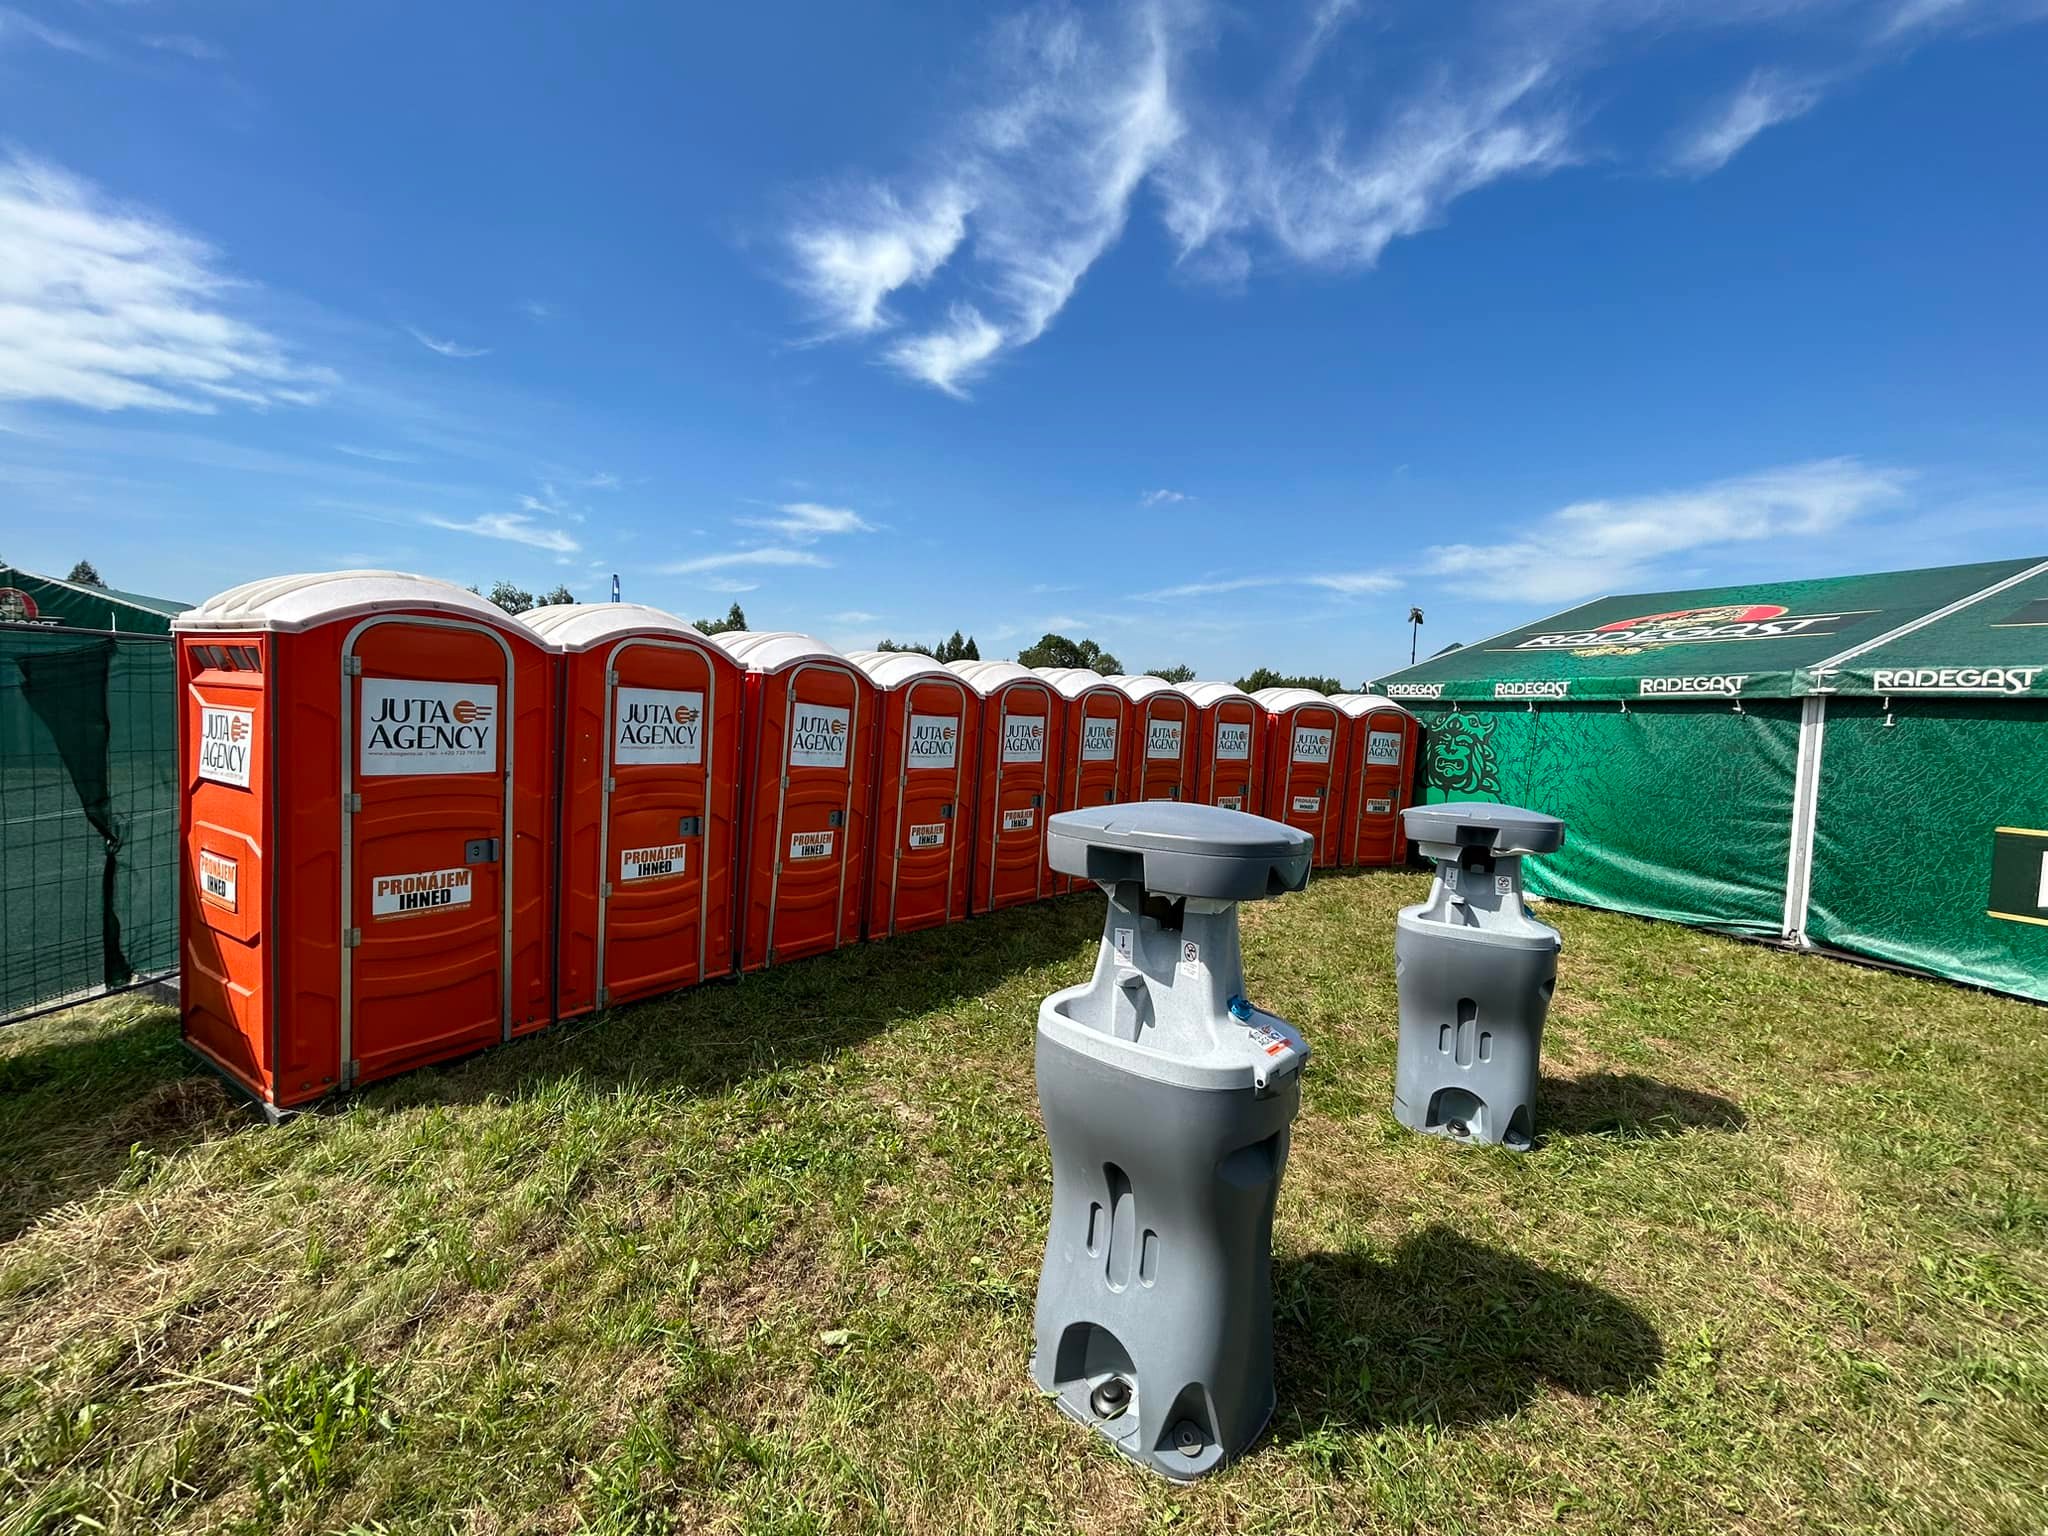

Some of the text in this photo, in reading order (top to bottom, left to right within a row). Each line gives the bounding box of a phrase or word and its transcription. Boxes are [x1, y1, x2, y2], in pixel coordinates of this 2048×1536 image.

[1515, 615, 1840, 648] RADEGAST
[1640, 675, 1749, 697] RADEGAST
[1874, 667, 2043, 694] RADEGAST
[1387, 684, 1445, 699] RADEGAST
[1494, 681, 1571, 698] RADEGAST
[370, 698, 450, 723] JUTA
[622, 703, 673, 724] JUTA
[203, 714, 229, 742] JUTA
[795, 716, 830, 734] JUTA
[1006, 725, 1031, 738] JUTA
[1086, 727, 1106, 738] JUTA
[368, 724, 489, 749] AGENCY
[620, 725, 697, 745] AGENCY
[913, 726, 942, 740] JUTA
[1151, 728, 1171, 739] JUTA
[1220, 731, 1239, 741] JUTA
[1296, 734, 1319, 745] JUTA
[793, 733, 845, 751] AGENCY
[910, 741, 955, 754] AGENCY
[1004, 738, 1042, 751] AGENCY
[1085, 738, 1113, 749] AGENCY
[1149, 739, 1180, 750] AGENCY
[1218, 741, 1247, 750] AGENCY
[1294, 744, 1329, 755] AGENCY
[1370, 738, 1390, 748] JUTA
[202, 741, 246, 773] AGENCY
[1368, 747, 1398, 757] AGENCY
[801, 845, 824, 856] IHNED
[638, 860, 672, 876] IHNED
[378, 871, 468, 896] PRONÁJEM
[400, 888, 451, 910] IHNED
